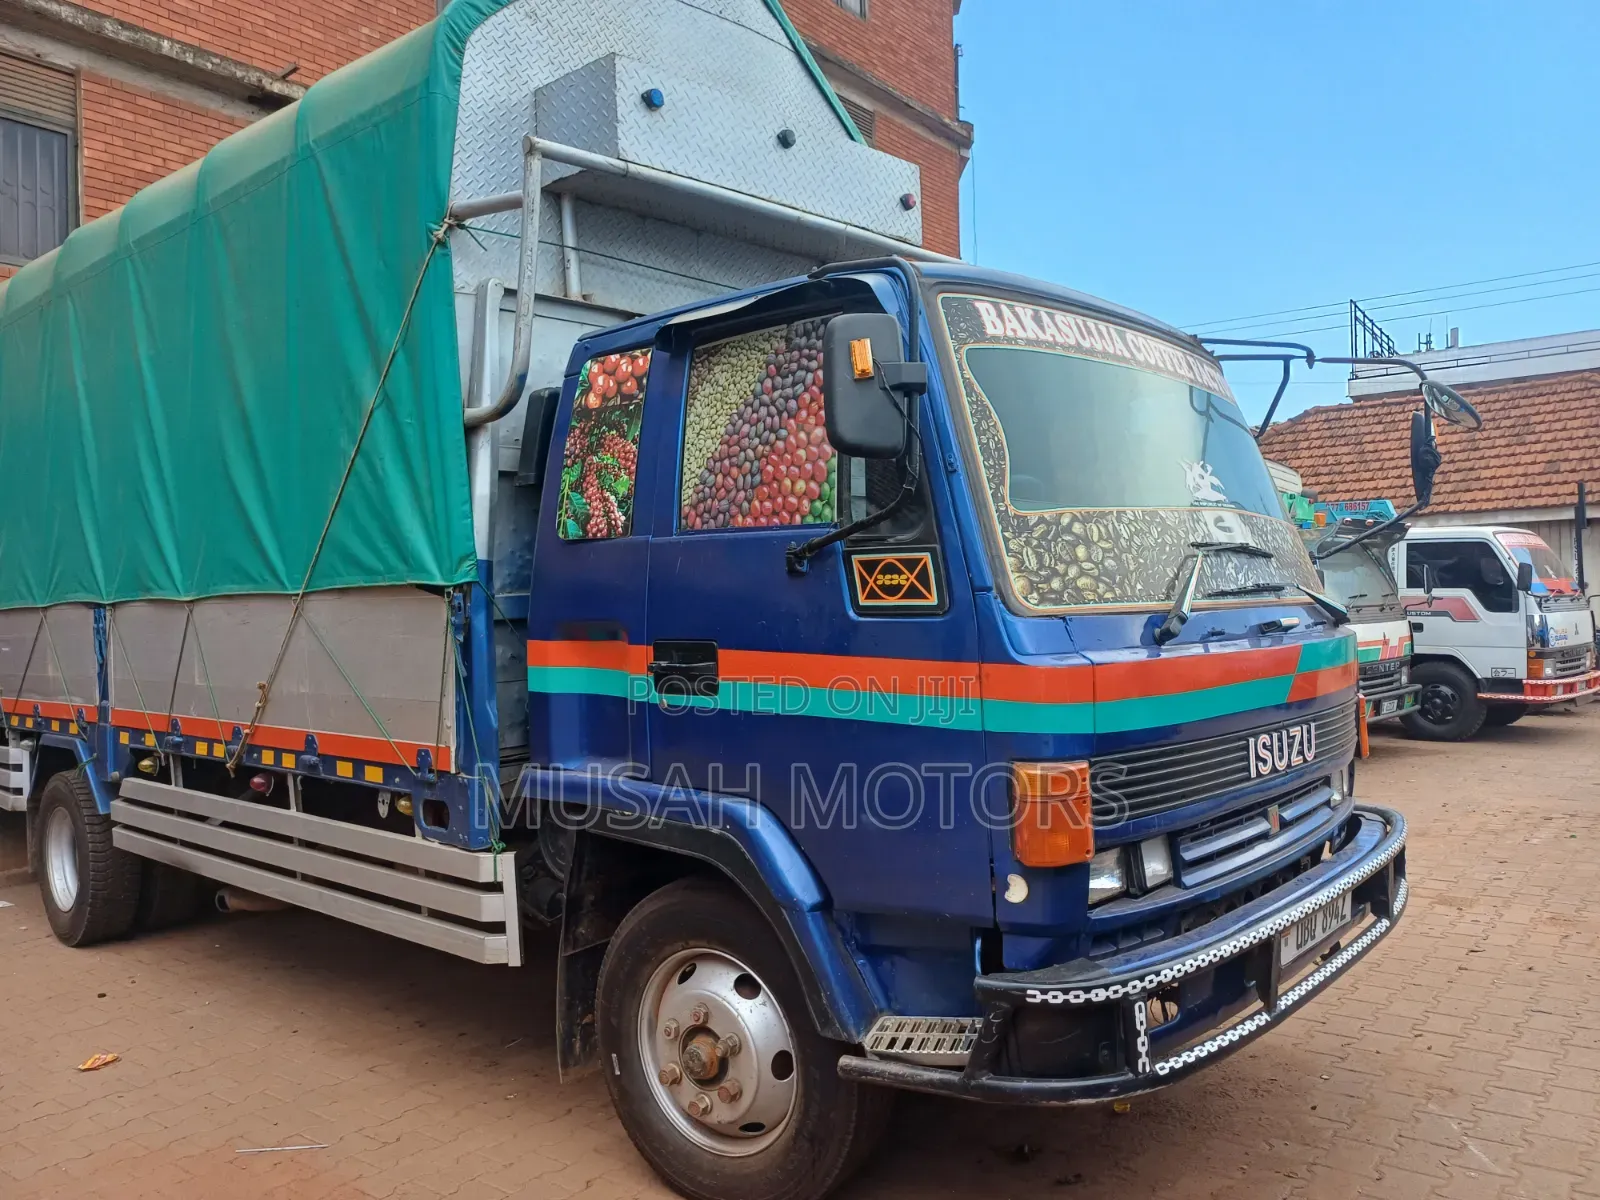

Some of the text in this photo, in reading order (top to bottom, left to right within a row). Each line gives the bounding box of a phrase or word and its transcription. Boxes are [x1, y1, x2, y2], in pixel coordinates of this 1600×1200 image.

[974, 301, 1132, 359] BAKASUJJA
[1125, 332, 1196, 380] COFFEE
[1247, 722, 1316, 779] ISUZU
